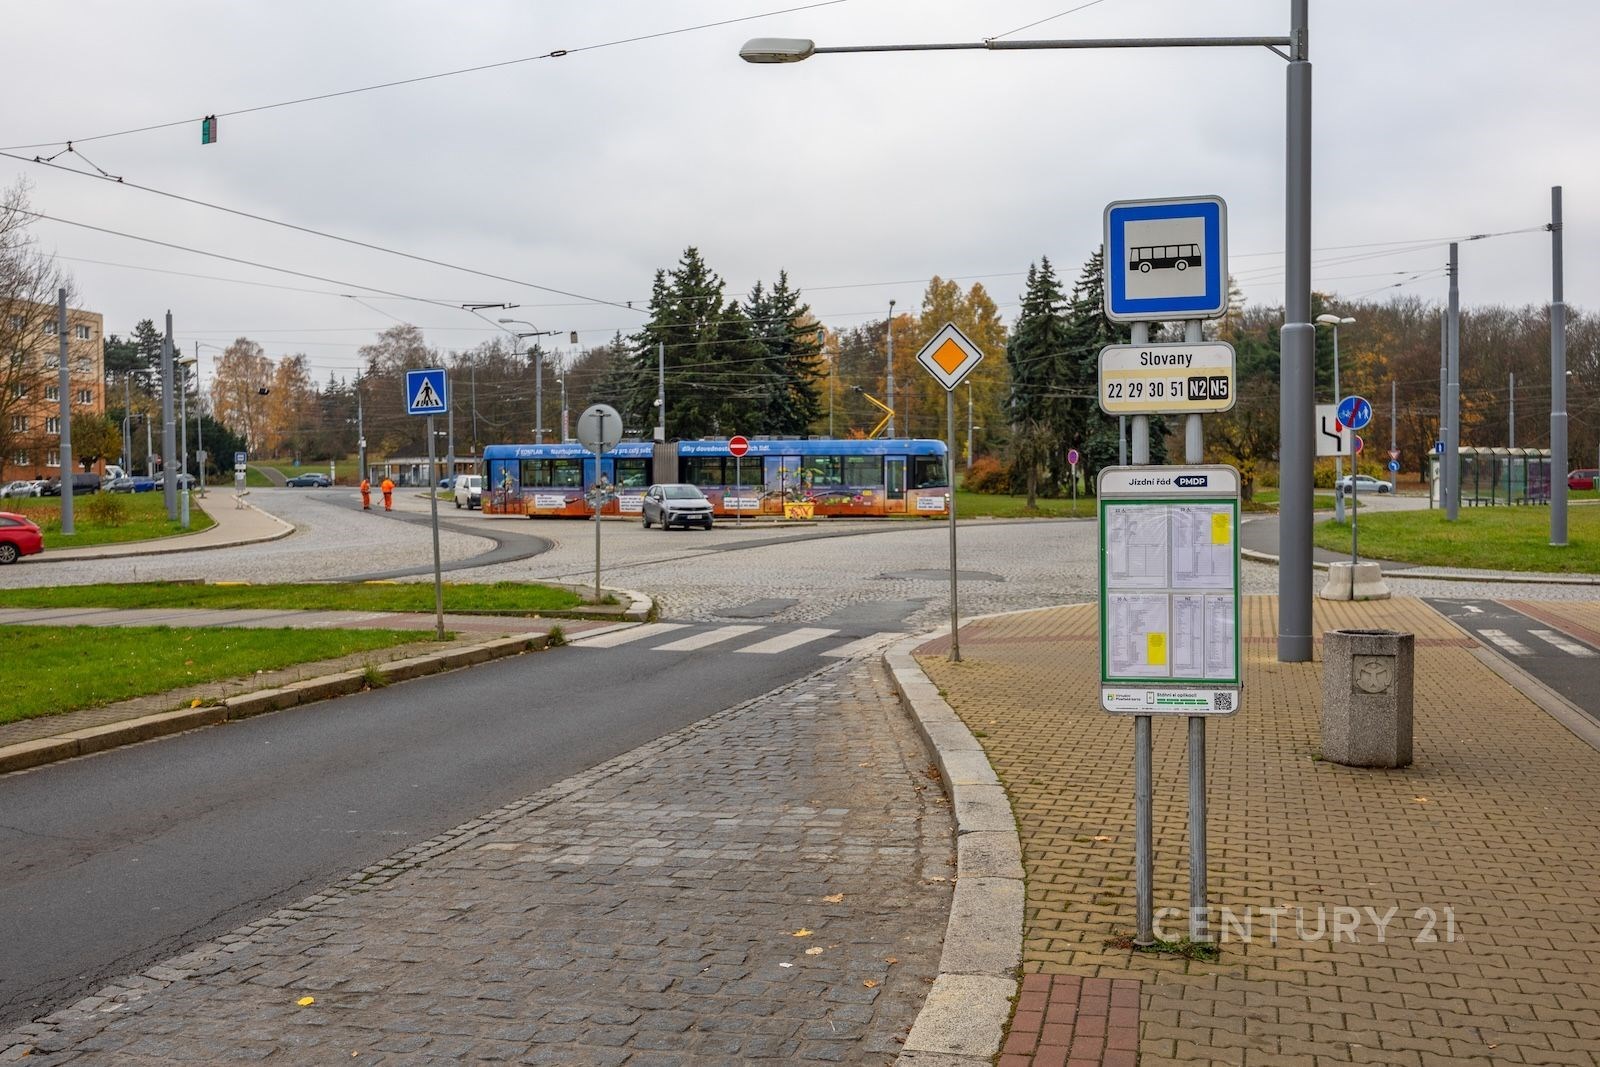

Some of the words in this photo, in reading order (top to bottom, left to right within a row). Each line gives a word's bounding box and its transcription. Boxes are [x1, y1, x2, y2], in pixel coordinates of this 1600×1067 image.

[1140, 352, 1192, 367] Slovany
[1108, 383, 1122, 398] 22
[1129, 383, 1142, 397] 29
[1149, 382, 1163, 397] 30
[1171, 382, 1183, 396] 51
[1190, 380, 1207, 396] N2
[1211, 379, 1227, 395] N5
[1129, 477, 1155, 486] Jízdní
[1156, 477, 1171, 486] řád
[1179, 477, 1206, 486] PMDP
